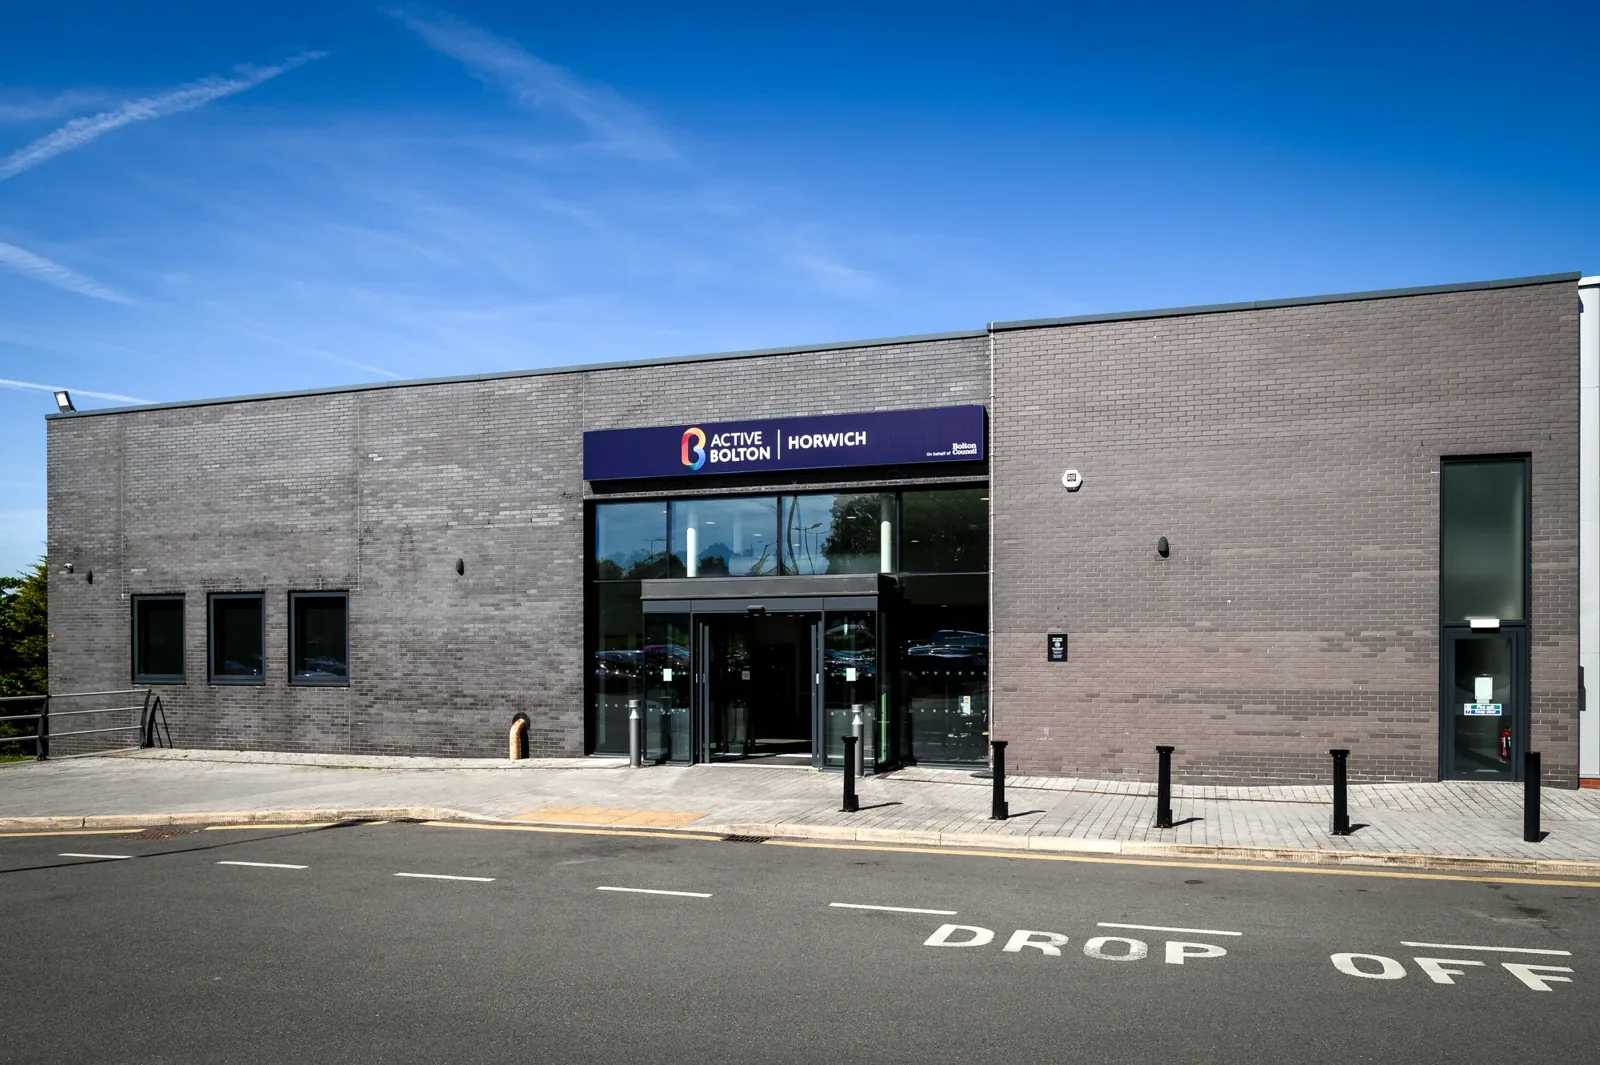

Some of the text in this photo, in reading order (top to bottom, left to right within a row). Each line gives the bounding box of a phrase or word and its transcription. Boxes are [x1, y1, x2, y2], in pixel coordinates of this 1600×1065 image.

[710, 430, 763, 448] ACTIVE
[788, 430, 867, 450] HORWICH
[709, 446, 771, 463] BOLTON
[923, 923, 1575, 992] DROP OFF
